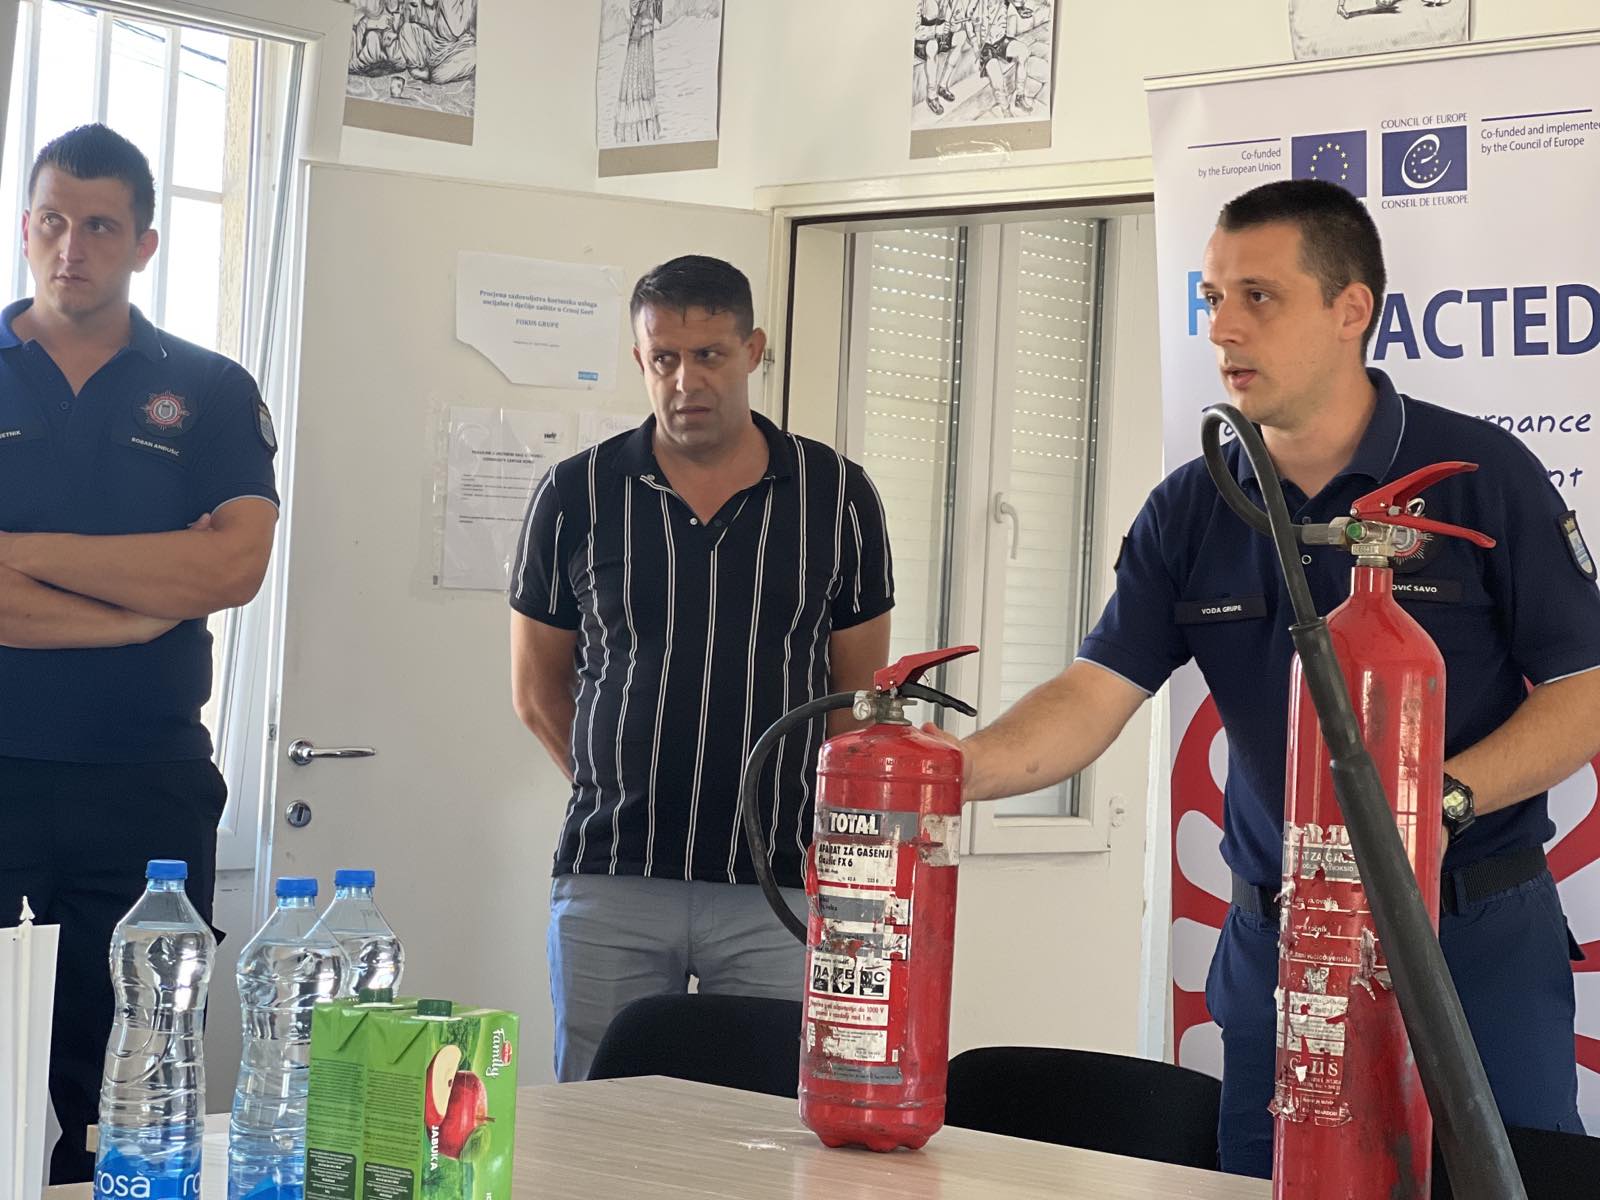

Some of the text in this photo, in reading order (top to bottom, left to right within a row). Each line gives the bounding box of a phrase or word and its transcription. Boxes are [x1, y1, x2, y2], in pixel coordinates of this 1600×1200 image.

[1381, 112, 1468, 129] COUNCIL OF EUROPE
[1481, 126, 1526, 139] Co-funded
[1527, 124, 1544, 135] and
[1481, 137, 1585, 155] by the Council of Europe
[1241, 147, 1282, 160] Co-funded
[1198, 162, 1282, 179] by the European Union
[1381, 198, 1418, 209] CONSEIL
[1419, 197, 1430, 207] DE
[1413, 585, 1437, 593] SAVO
[829, 812, 879, 836] TOTAL
[843, 846, 854, 856] ZA
[837, 857, 847, 867] FX
[847, 858, 853, 867] 6
[874, 971, 885, 982] C
[430, 1124, 440, 1171] JABUKA
